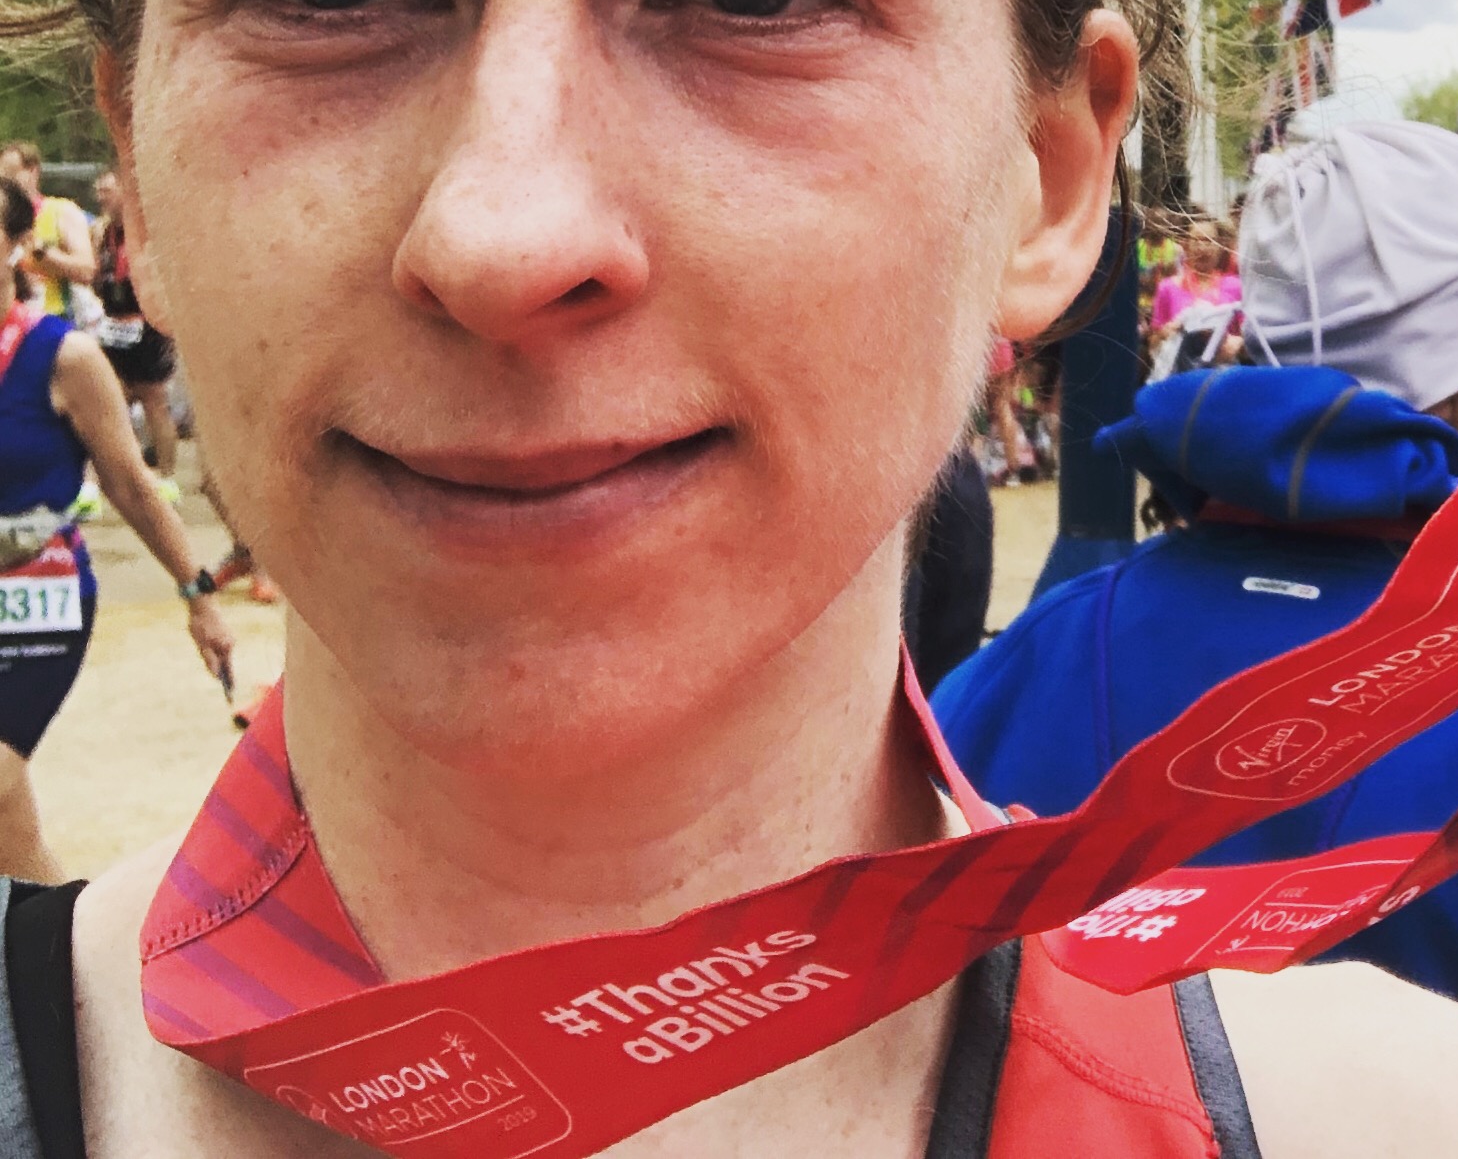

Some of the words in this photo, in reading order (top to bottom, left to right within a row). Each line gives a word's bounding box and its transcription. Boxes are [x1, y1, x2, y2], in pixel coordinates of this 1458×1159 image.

[1234, 724, 1303, 770] Virgin
[1287, 730, 1368, 786] money
[539, 929, 818, 1037] #Thanks
[622, 962, 851, 1065] aBillion
[329, 1057, 450, 1113] LONDON
[354, 1067, 518, 1139] MARATHON
[497, 1105, 538, 1132] 2019
